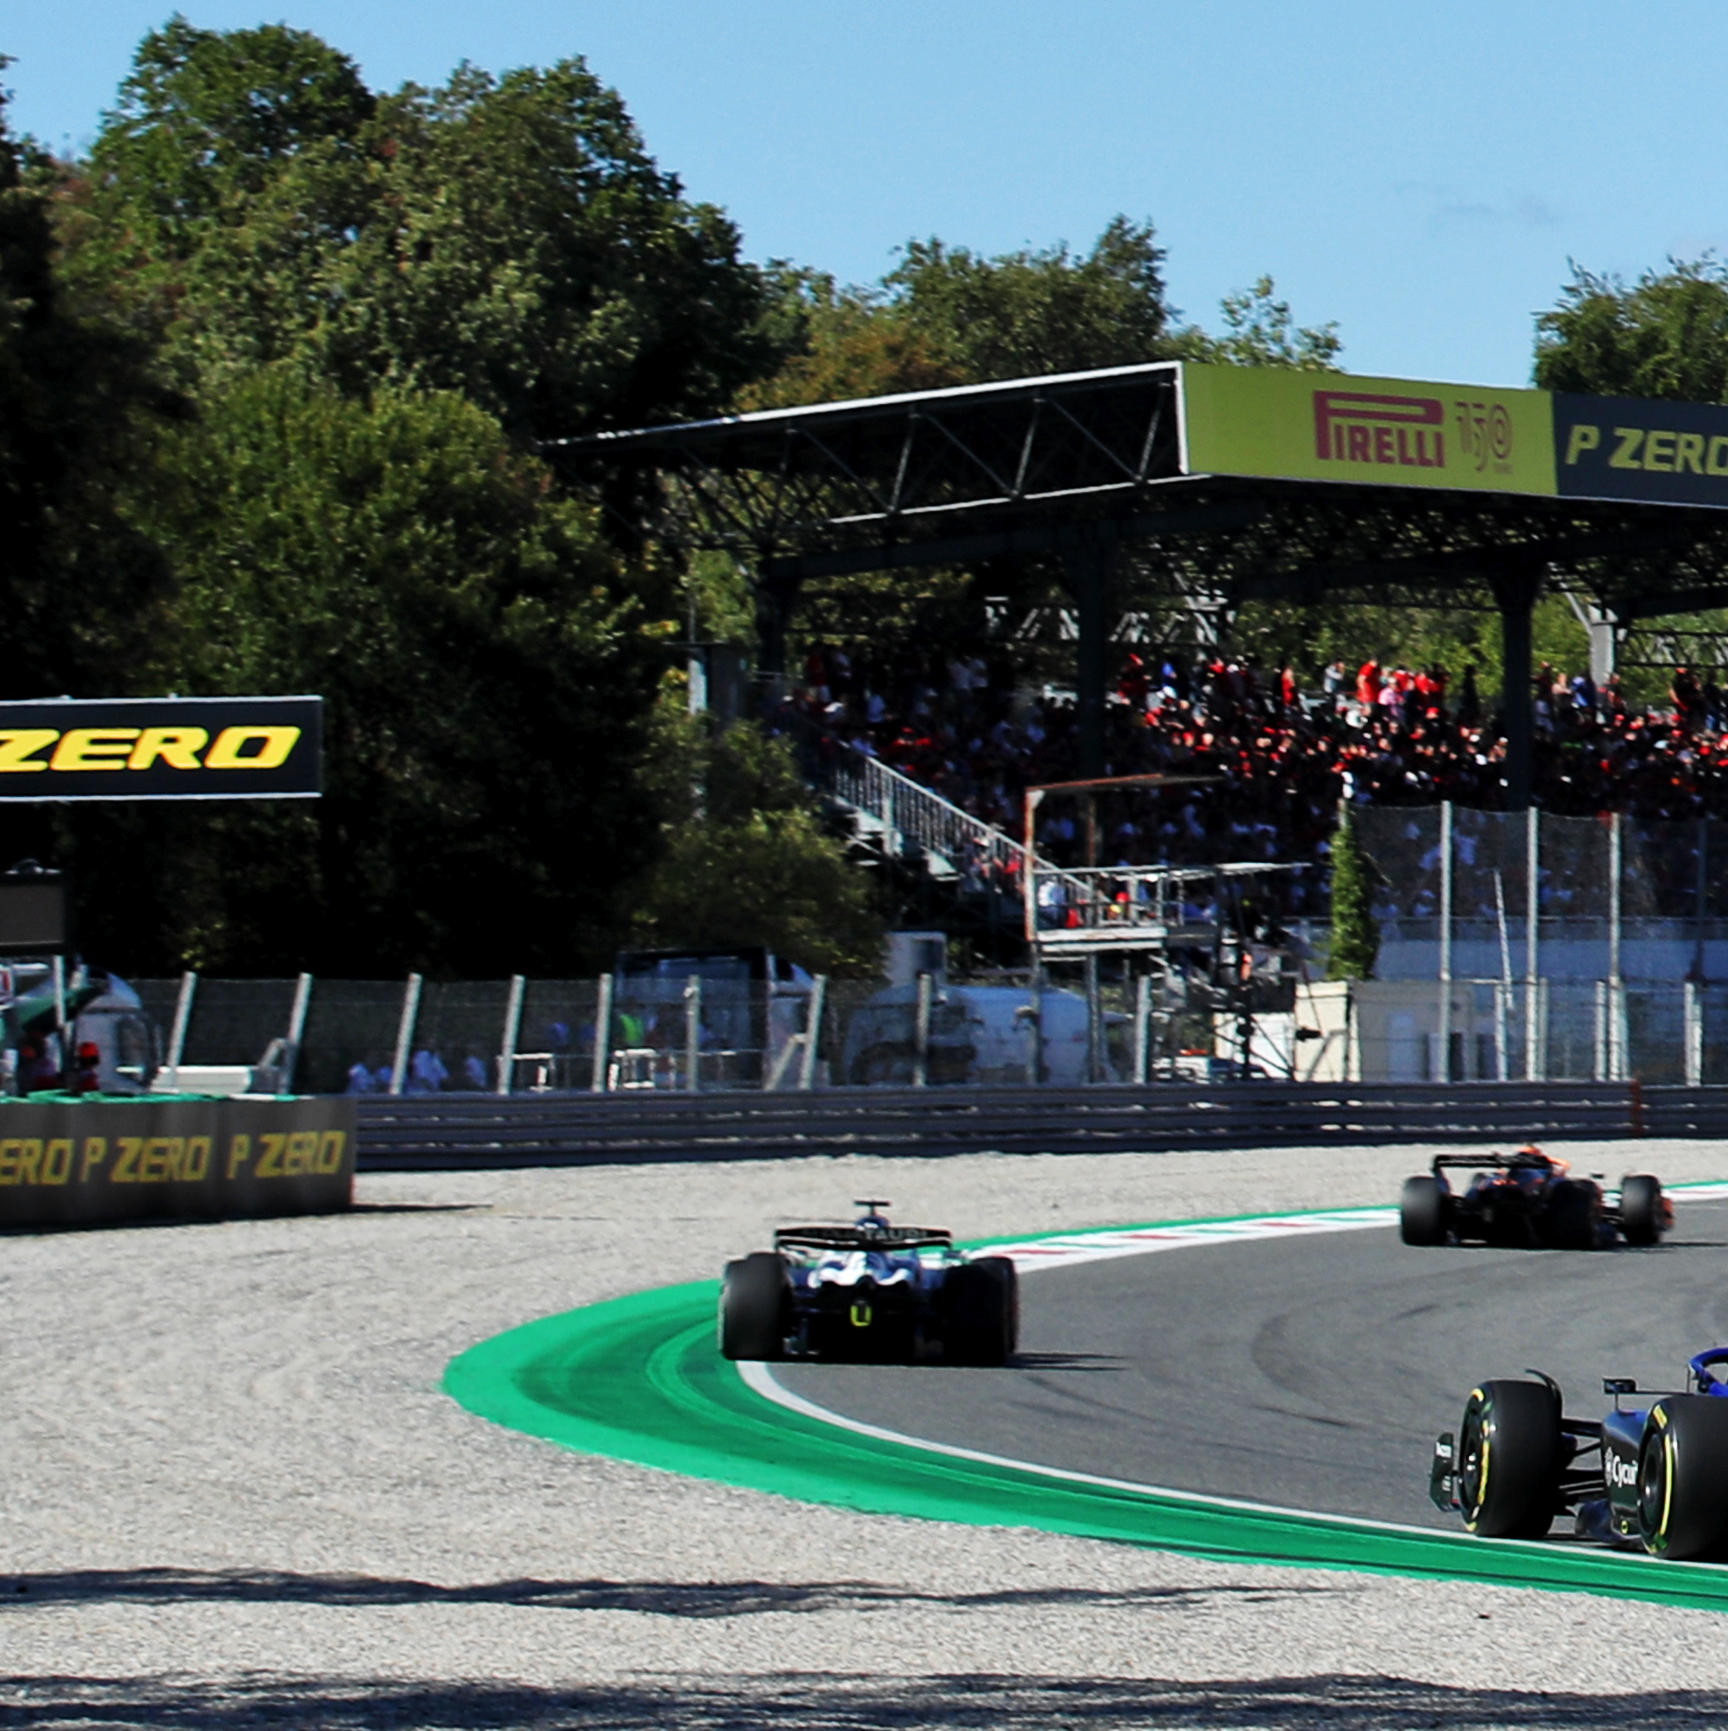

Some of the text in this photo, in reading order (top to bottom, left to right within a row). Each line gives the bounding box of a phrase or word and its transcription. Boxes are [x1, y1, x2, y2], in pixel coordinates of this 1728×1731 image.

[1312, 390, 1446, 468] PIRELLI
[1565, 425, 1600, 465] P
[0, 726, 302, 772] ZERO
[79, 1136, 107, 1183] P
[110, 1135, 212, 1183] ZERO
[226, 1133, 250, 1179] P
[255, 1130, 347, 1178] ZERO
